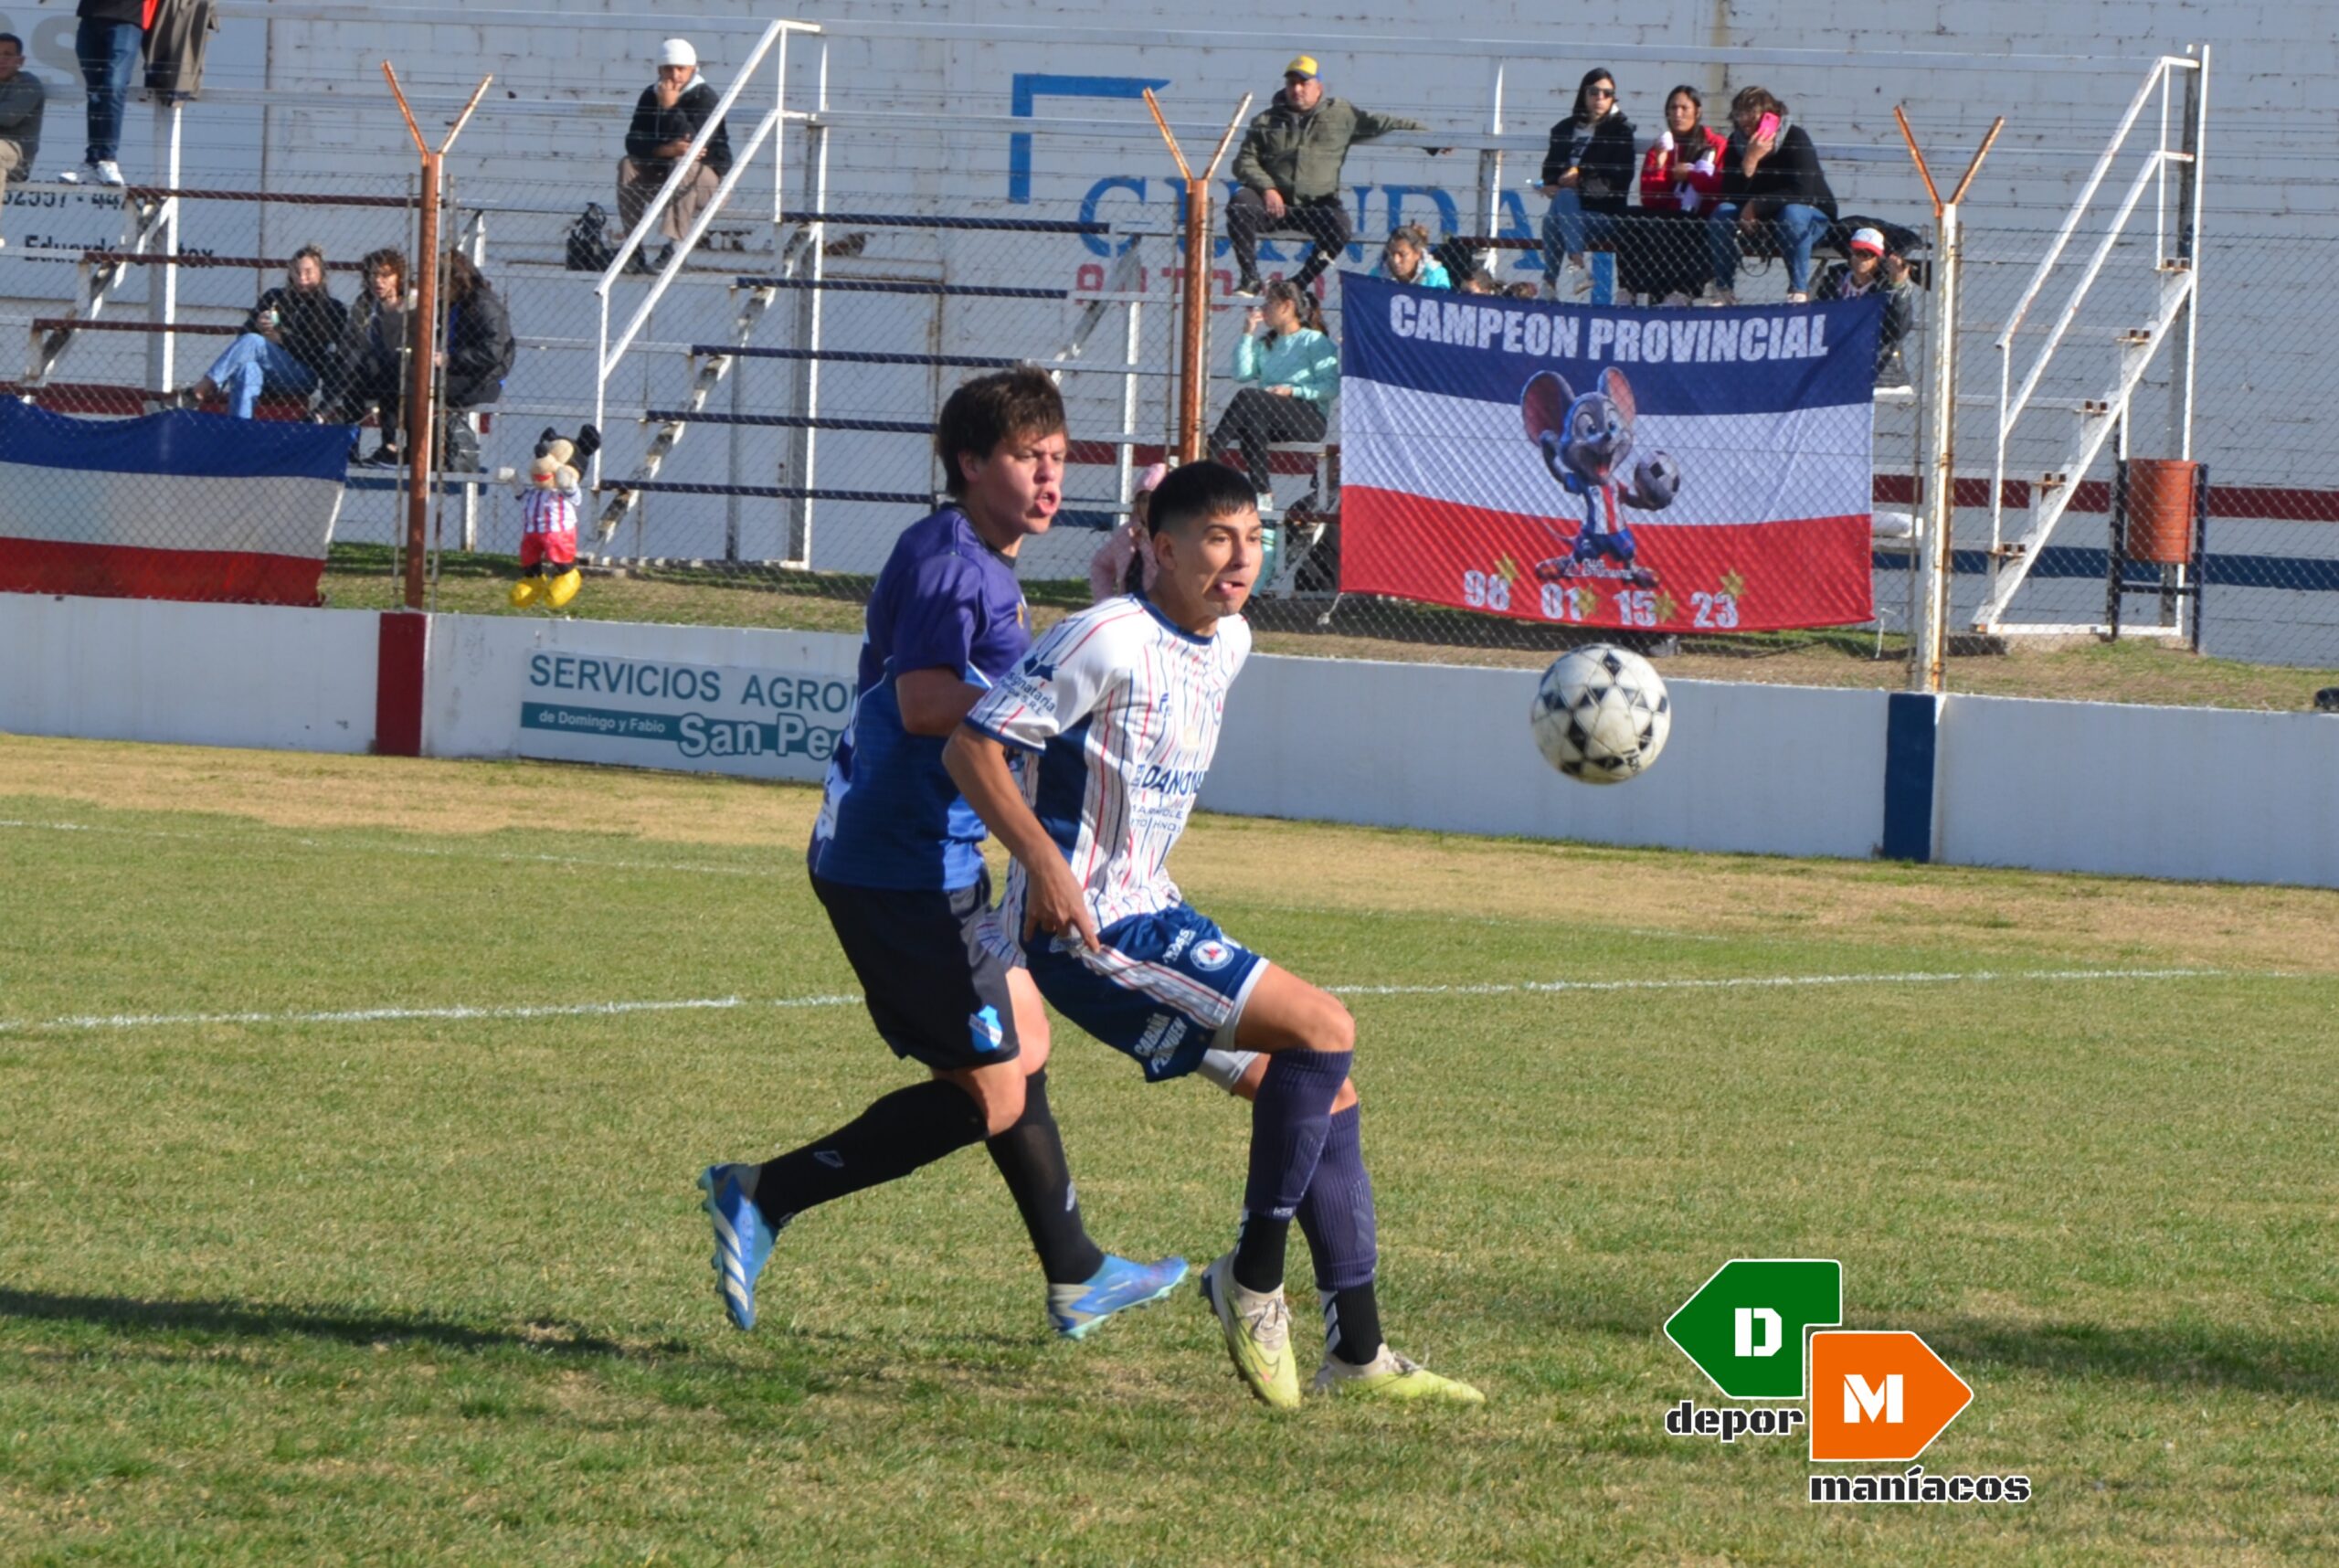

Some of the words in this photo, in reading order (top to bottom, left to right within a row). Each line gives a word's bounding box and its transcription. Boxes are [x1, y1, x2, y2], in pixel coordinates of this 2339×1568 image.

[1390, 294, 1580, 358] CAMPEON
[1588, 314, 1829, 364] PROVINCIAL
[1464, 570, 1510, 611] 98
[1540, 583, 1583, 621] 01
[1614, 589, 1657, 627] 15
[1692, 592, 1740, 629] 23
[529, 654, 722, 702] SERVICIOS
[741, 674, 857, 714] AGRO
[539, 711, 556, 723] de
[558, 711, 615, 730] Domingo
[619, 718, 627, 733] y
[630, 718, 666, 734] Fabio
[677, 713, 763, 758] San
[777, 713, 844, 760] Pe
